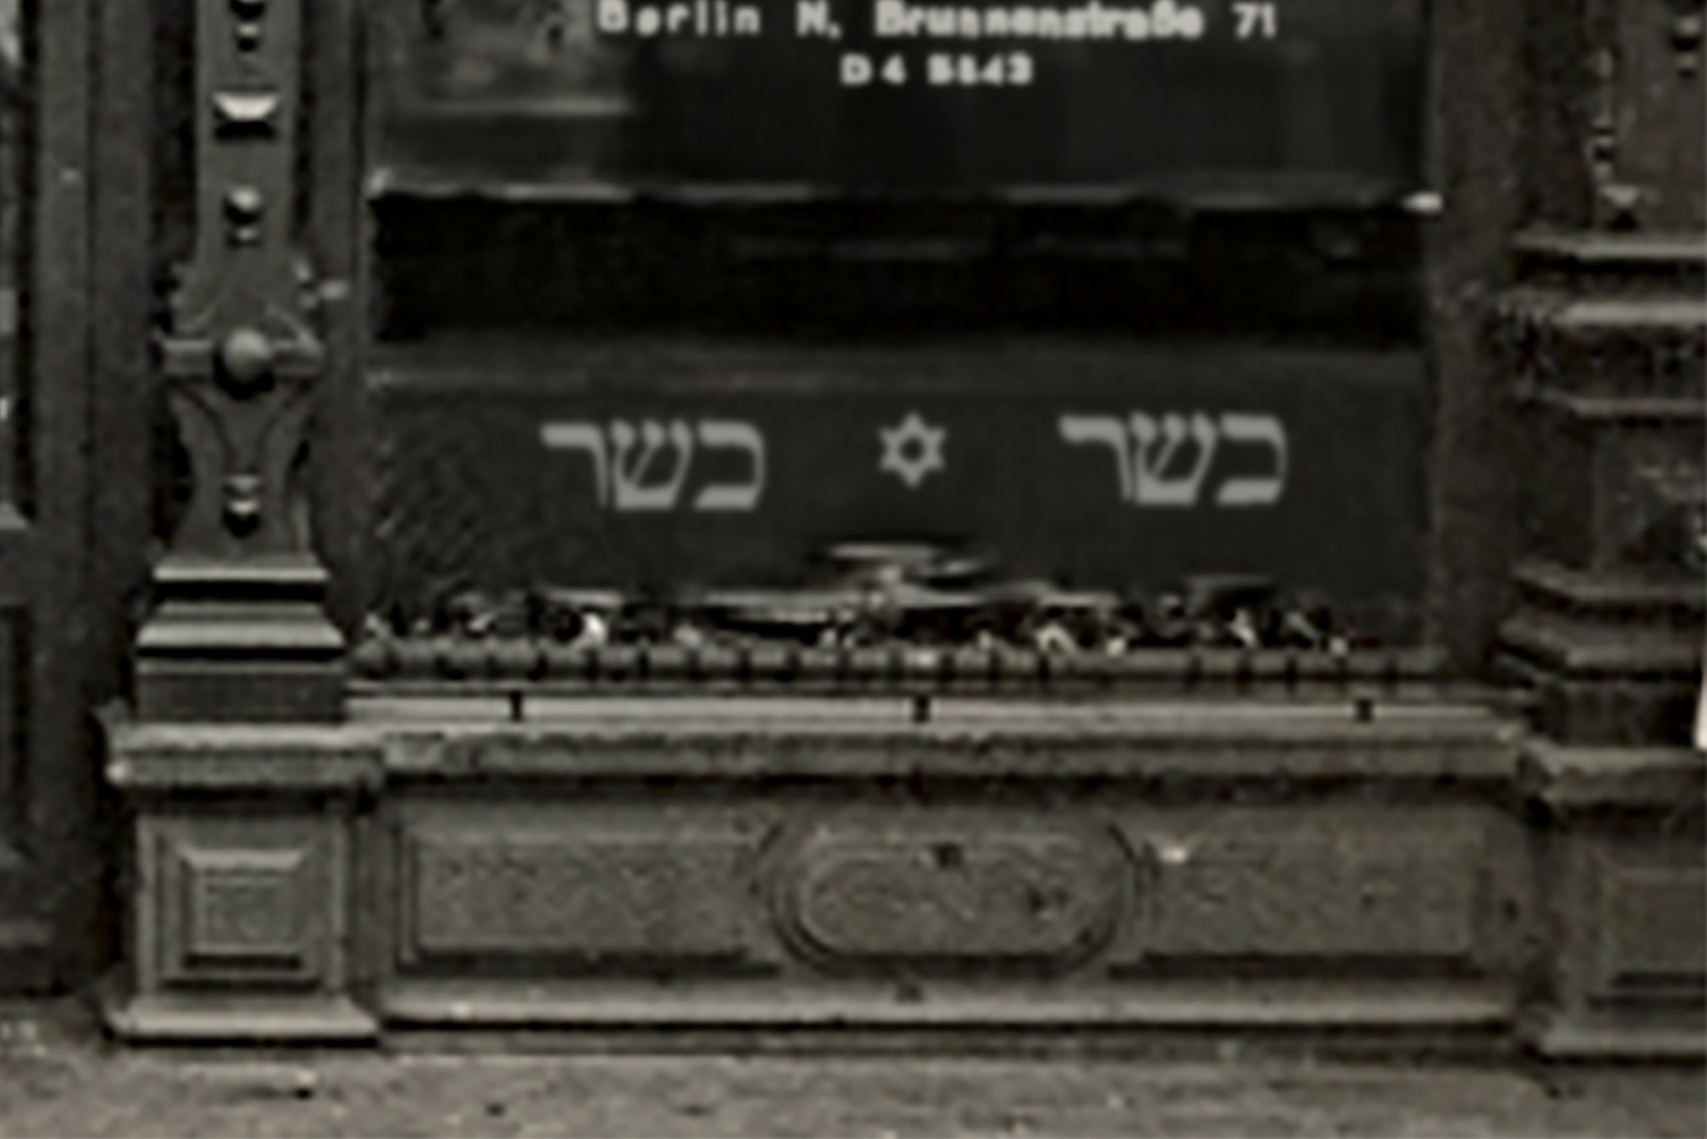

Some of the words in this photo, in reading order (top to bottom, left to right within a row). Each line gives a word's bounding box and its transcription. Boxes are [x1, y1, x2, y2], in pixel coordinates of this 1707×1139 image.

[1231, 1, 1277, 39] 71
[540, 421, 764, 512] כשר
[1059, 411, 1289, 507] כשר
